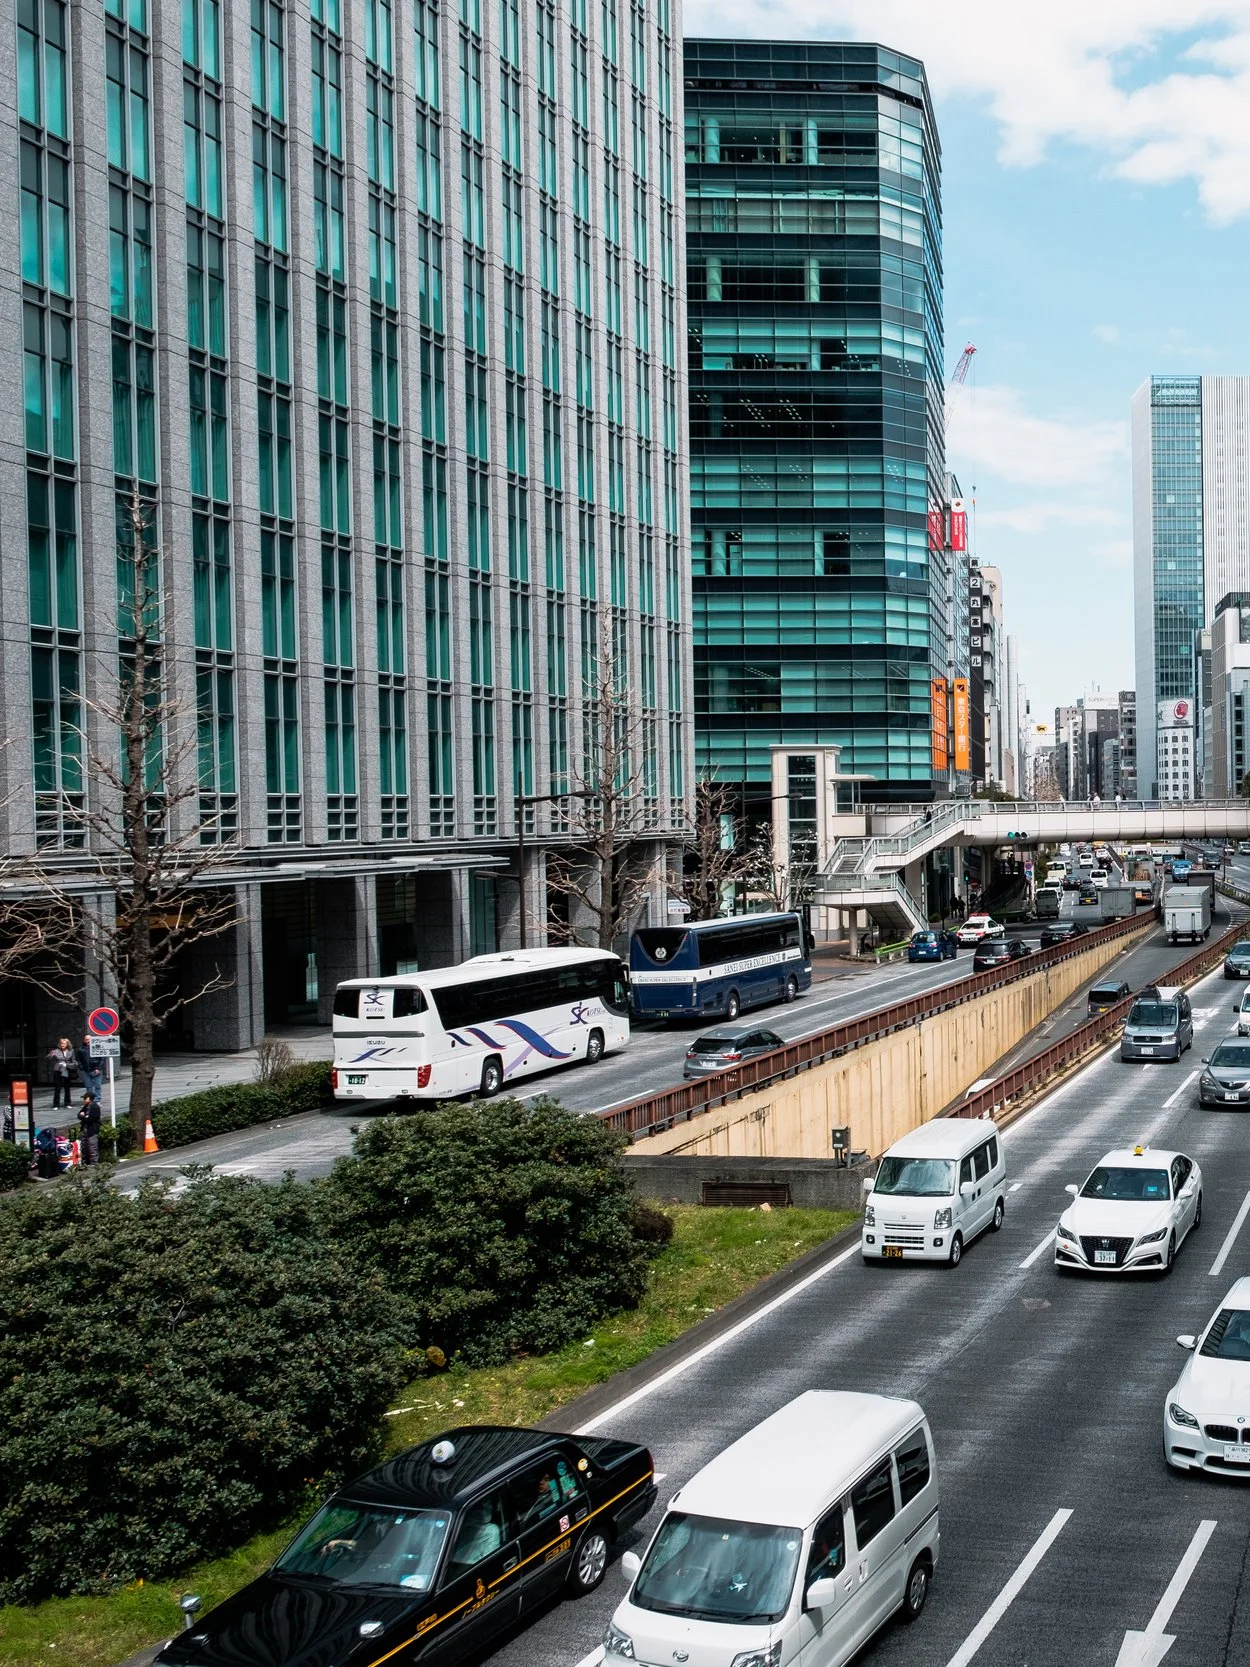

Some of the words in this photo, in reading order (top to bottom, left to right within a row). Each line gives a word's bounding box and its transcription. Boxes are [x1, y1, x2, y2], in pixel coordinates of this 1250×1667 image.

[957, 697, 966, 753] 東京スター銀行
